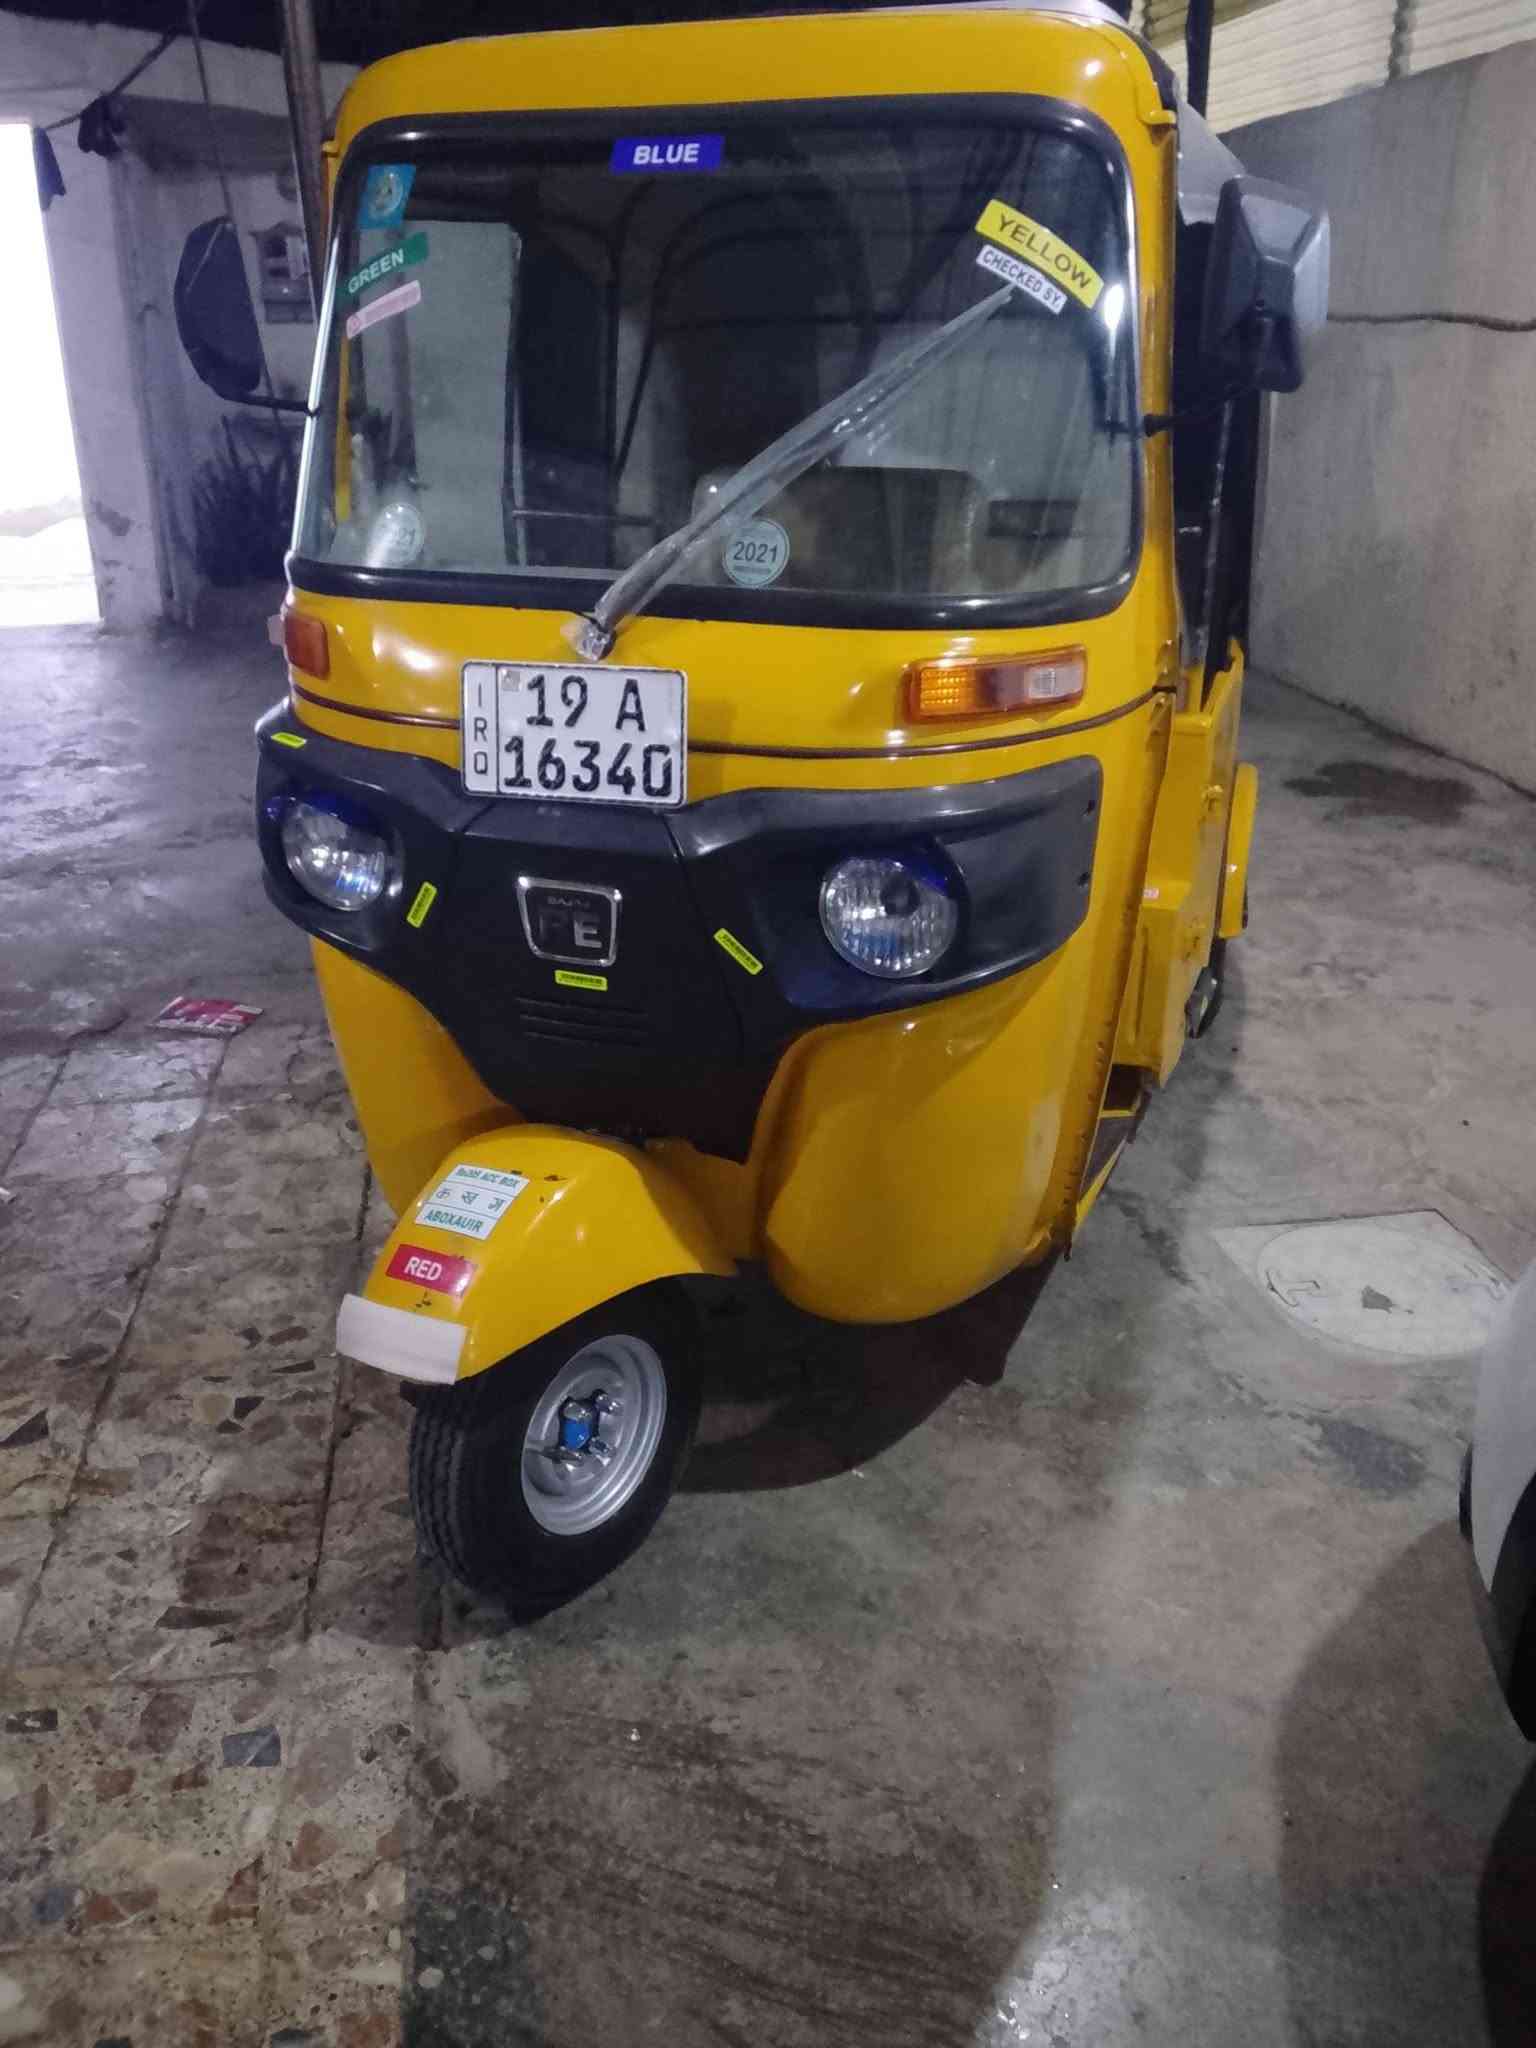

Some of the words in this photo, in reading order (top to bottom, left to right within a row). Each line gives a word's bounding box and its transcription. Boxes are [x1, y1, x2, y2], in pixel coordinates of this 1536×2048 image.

[633, 142, 701, 165] BLUE
[348, 248, 404, 293] GREEN
[983, 250, 1042, 293] CHECKED
[998, 213, 1091, 290] YELLOW
[733, 541, 778, 563] 2021
[526, 674, 589, 727] 19
[615, 678, 646, 732] A
[503, 735, 673, 797] 16340
[404, 1256, 442, 1281] RED
